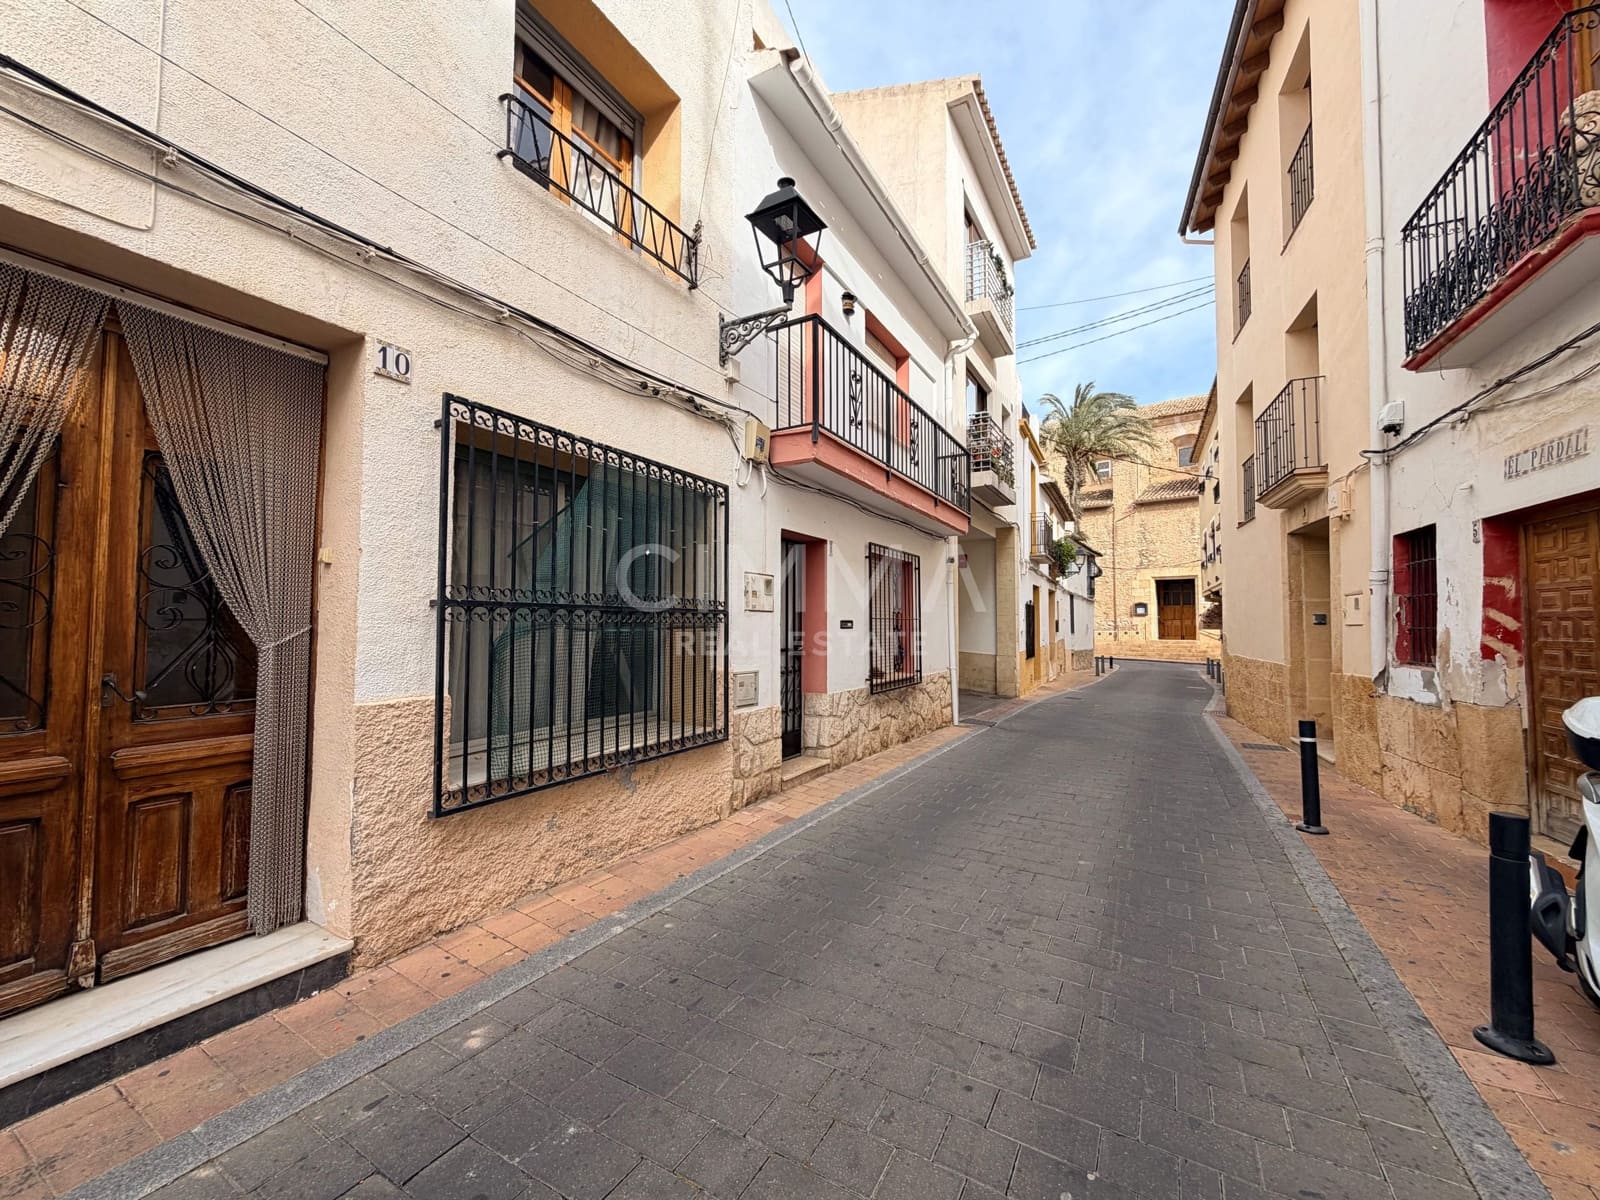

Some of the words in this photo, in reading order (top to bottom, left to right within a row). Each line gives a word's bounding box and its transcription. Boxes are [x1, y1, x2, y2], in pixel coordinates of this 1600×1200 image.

[378, 346, 410, 376] 10
[1508, 457, 1521, 475] EL
[1531, 434, 1583, 467] PARDAL
